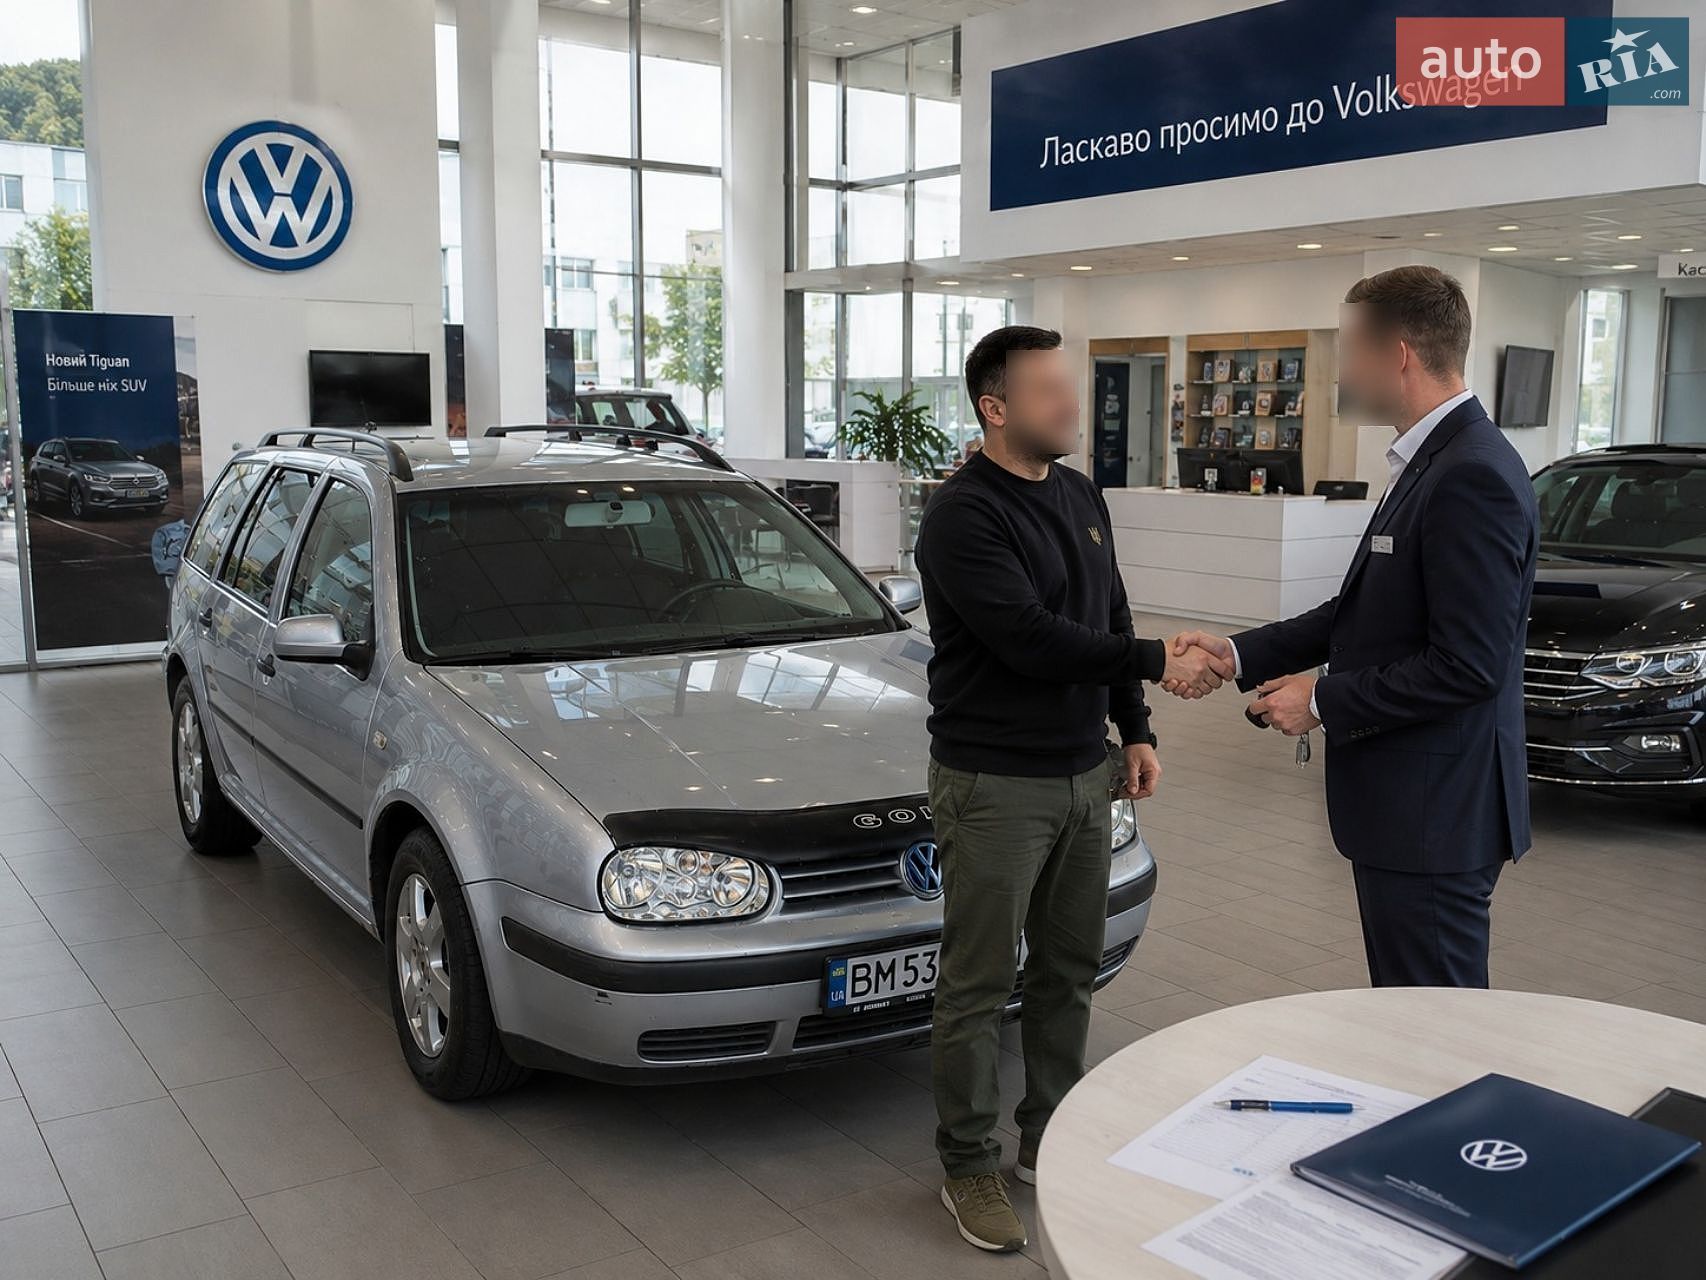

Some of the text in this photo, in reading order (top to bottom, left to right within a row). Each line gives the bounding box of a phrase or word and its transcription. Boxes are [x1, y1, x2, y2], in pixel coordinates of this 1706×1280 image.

[1039, 65, 1522, 168] Ласкаво просимо до Volkswagen
[213, 129, 347, 263] VW
[45, 352, 130, 370] Новий Tiguan
[47, 377, 95, 391] Більше
[121, 379, 147, 392] SUV
[831, 990, 845, 1001] UA
